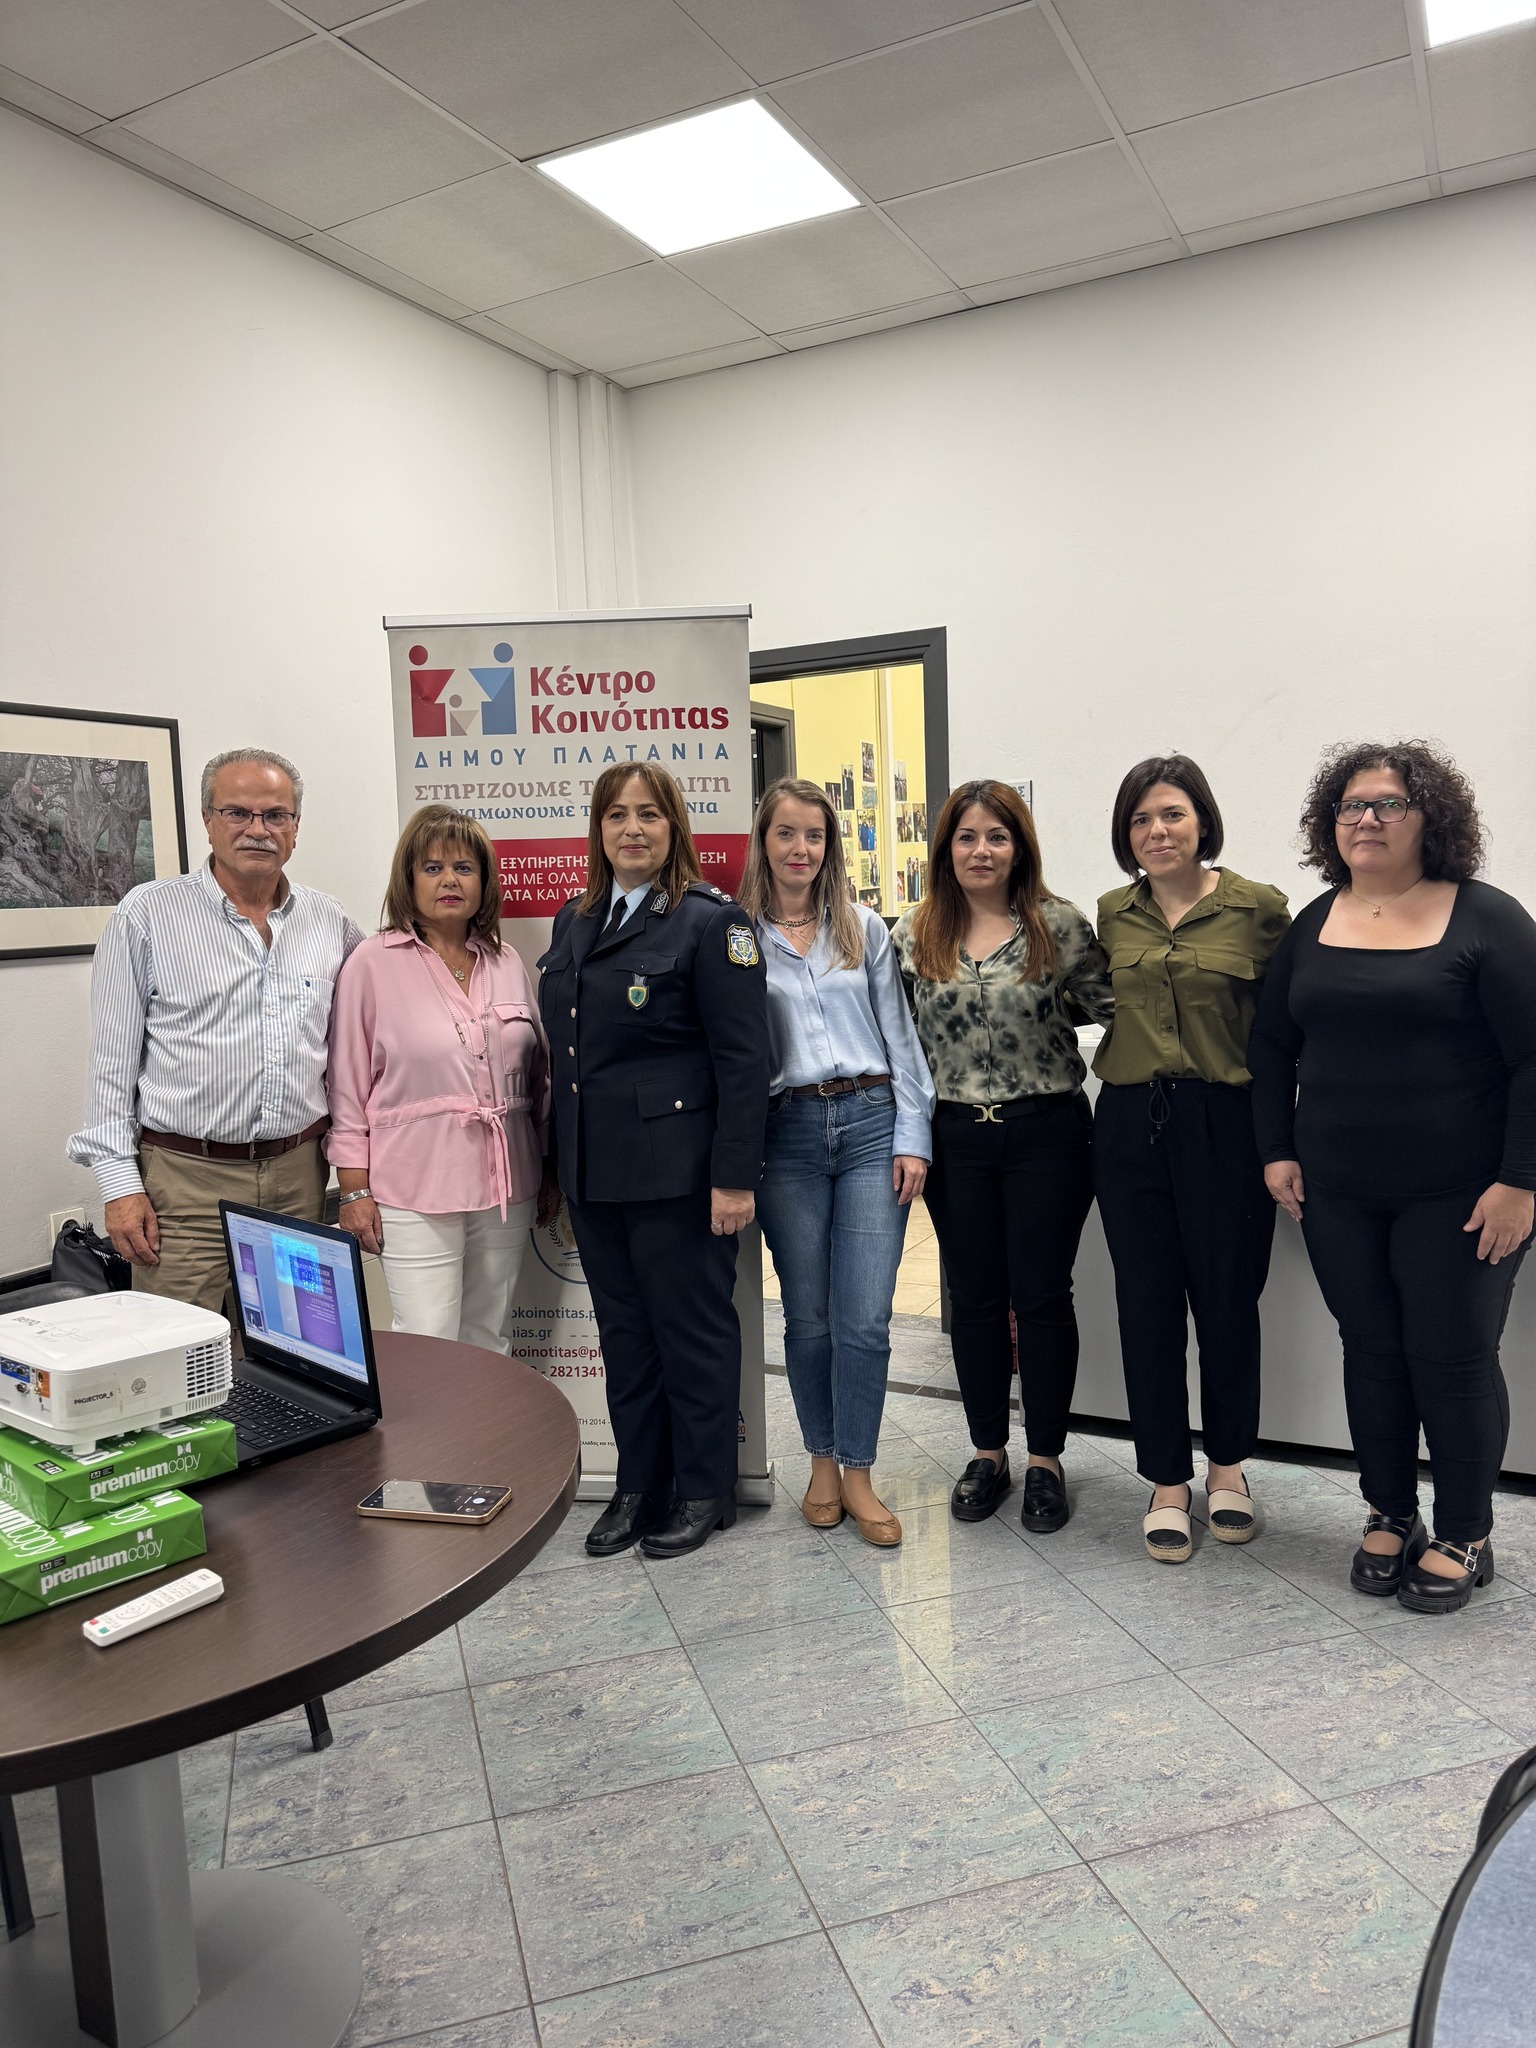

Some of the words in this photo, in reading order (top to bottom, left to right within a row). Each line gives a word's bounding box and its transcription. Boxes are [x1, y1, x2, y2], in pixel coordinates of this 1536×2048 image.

[529, 664, 656, 700] Κέντρο
[531, 701, 730, 734] Κοινότητας
[414, 747, 527, 769] ΔΗΜΟΥ
[553, 742, 730, 764] ΠΛΑΤΑΝΙΑ
[500, 854, 589, 870] ΕΞΥΠΗΡΕΤΗΣ
[699, 851, 727, 864] ΕΣΗ
[523, 873, 544, 885] ΜΕ
[548, 871, 580, 885] ΟΛΑ
[503, 889, 533, 902] ΑΤΑ
[536, 889, 560, 901] ΚΑΙ
[511, 1345, 602, 1360] koinotitas@pl
[549, 1366, 604, 1378] 2821341
[589, 1418, 606, 1426] 2014
